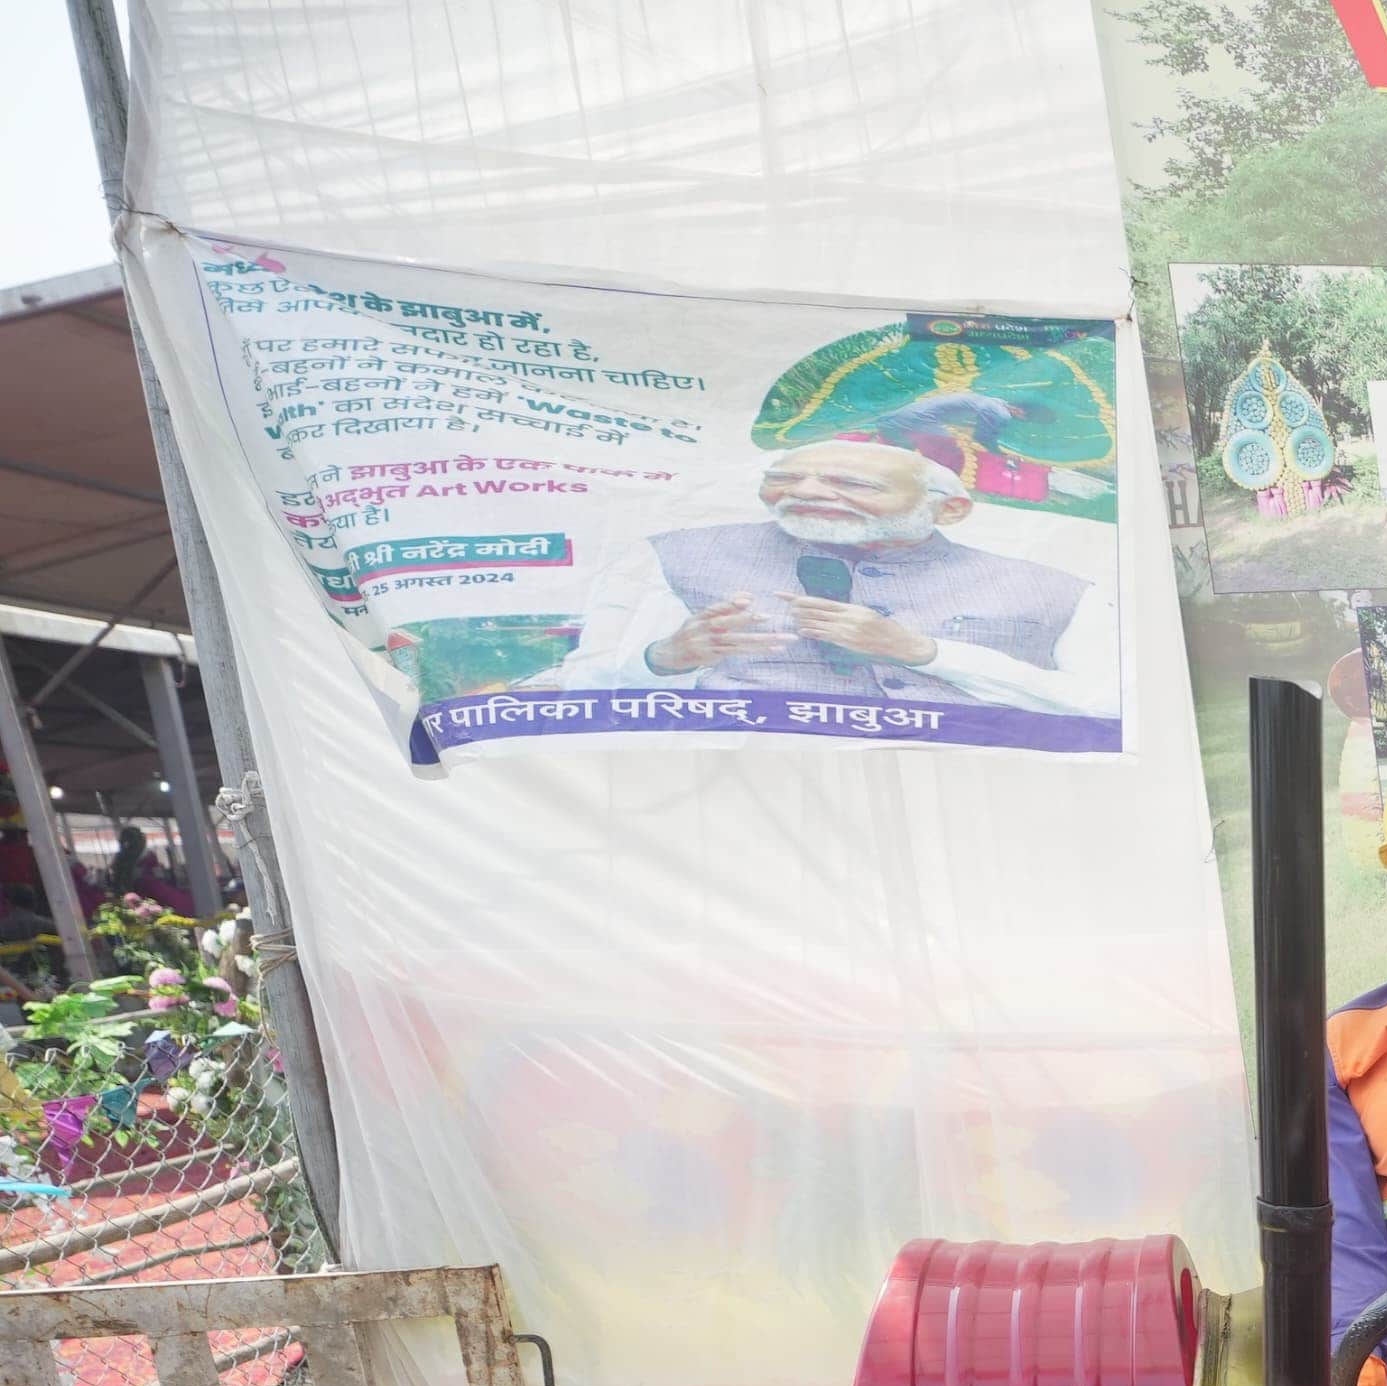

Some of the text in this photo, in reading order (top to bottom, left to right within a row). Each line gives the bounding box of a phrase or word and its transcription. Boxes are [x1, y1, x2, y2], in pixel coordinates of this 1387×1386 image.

[399, 299, 504, 328] झाबुआ
[253, 339, 295, 353] पर
[301, 335, 384, 353] हमारे
[473, 330, 505, 352] हो
[511, 337, 561, 358] रहा
[566, 338, 599, 363] है,
[356, 355, 389, 372] ने
[332, 397, 376, 413] का
[413, 377, 447, 393] ने
[451, 379, 511, 404] हमें
[659, 426, 699, 445] to
[327, 417, 437, 437] दिखाया
[348, 459, 449, 482] झाबुआ
[453, 454, 488, 472] के
[415, 483, 468, 498] Art
[473, 479, 589, 495] Works
[363, 536, 552, 566] श्री नरेंद्र मोदी
[372, 582, 389, 598] 25
[394, 574, 454, 592] अगस्त
[459, 571, 515, 585] 2024
[450, 695, 599, 728] पालिका
[785, 700, 945, 733] झाबुआ
